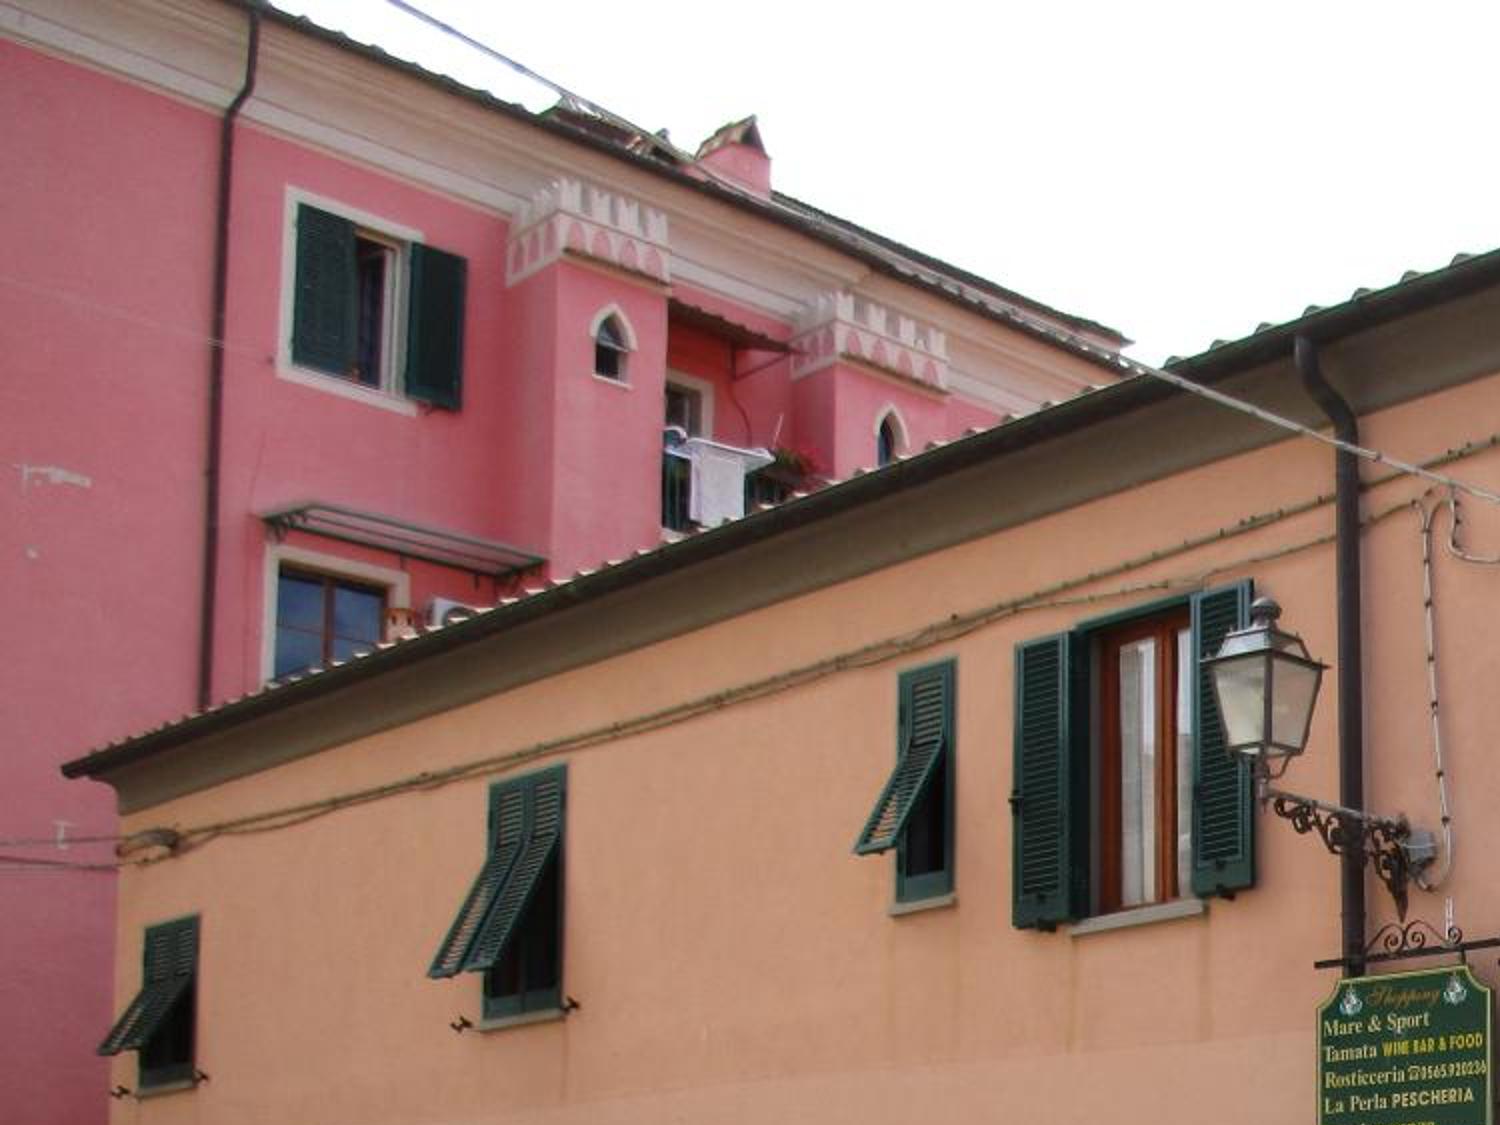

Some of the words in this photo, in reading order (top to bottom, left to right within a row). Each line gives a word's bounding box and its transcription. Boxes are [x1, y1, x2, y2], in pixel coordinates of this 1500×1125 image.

[1367, 987, 1440, 1008] Shopping
[1324, 1020, 1362, 1037] Mare
[1368, 1014, 1381, 1033] &
[1387, 1011, 1430, 1033] Sport
[1325, 1045, 1377, 1063] Tamata
[1382, 1040, 1408, 1057] WINE
[1413, 1038, 1435, 1055] BAR
[1450, 1033, 1483, 1049] FOOD
[1325, 1066, 1405, 1088] Rosticceria
[1325, 1097, 1344, 1114] La
[1350, 1093, 1387, 1112] Perla
[1392, 1087, 1474, 1108] PESCHERIA
